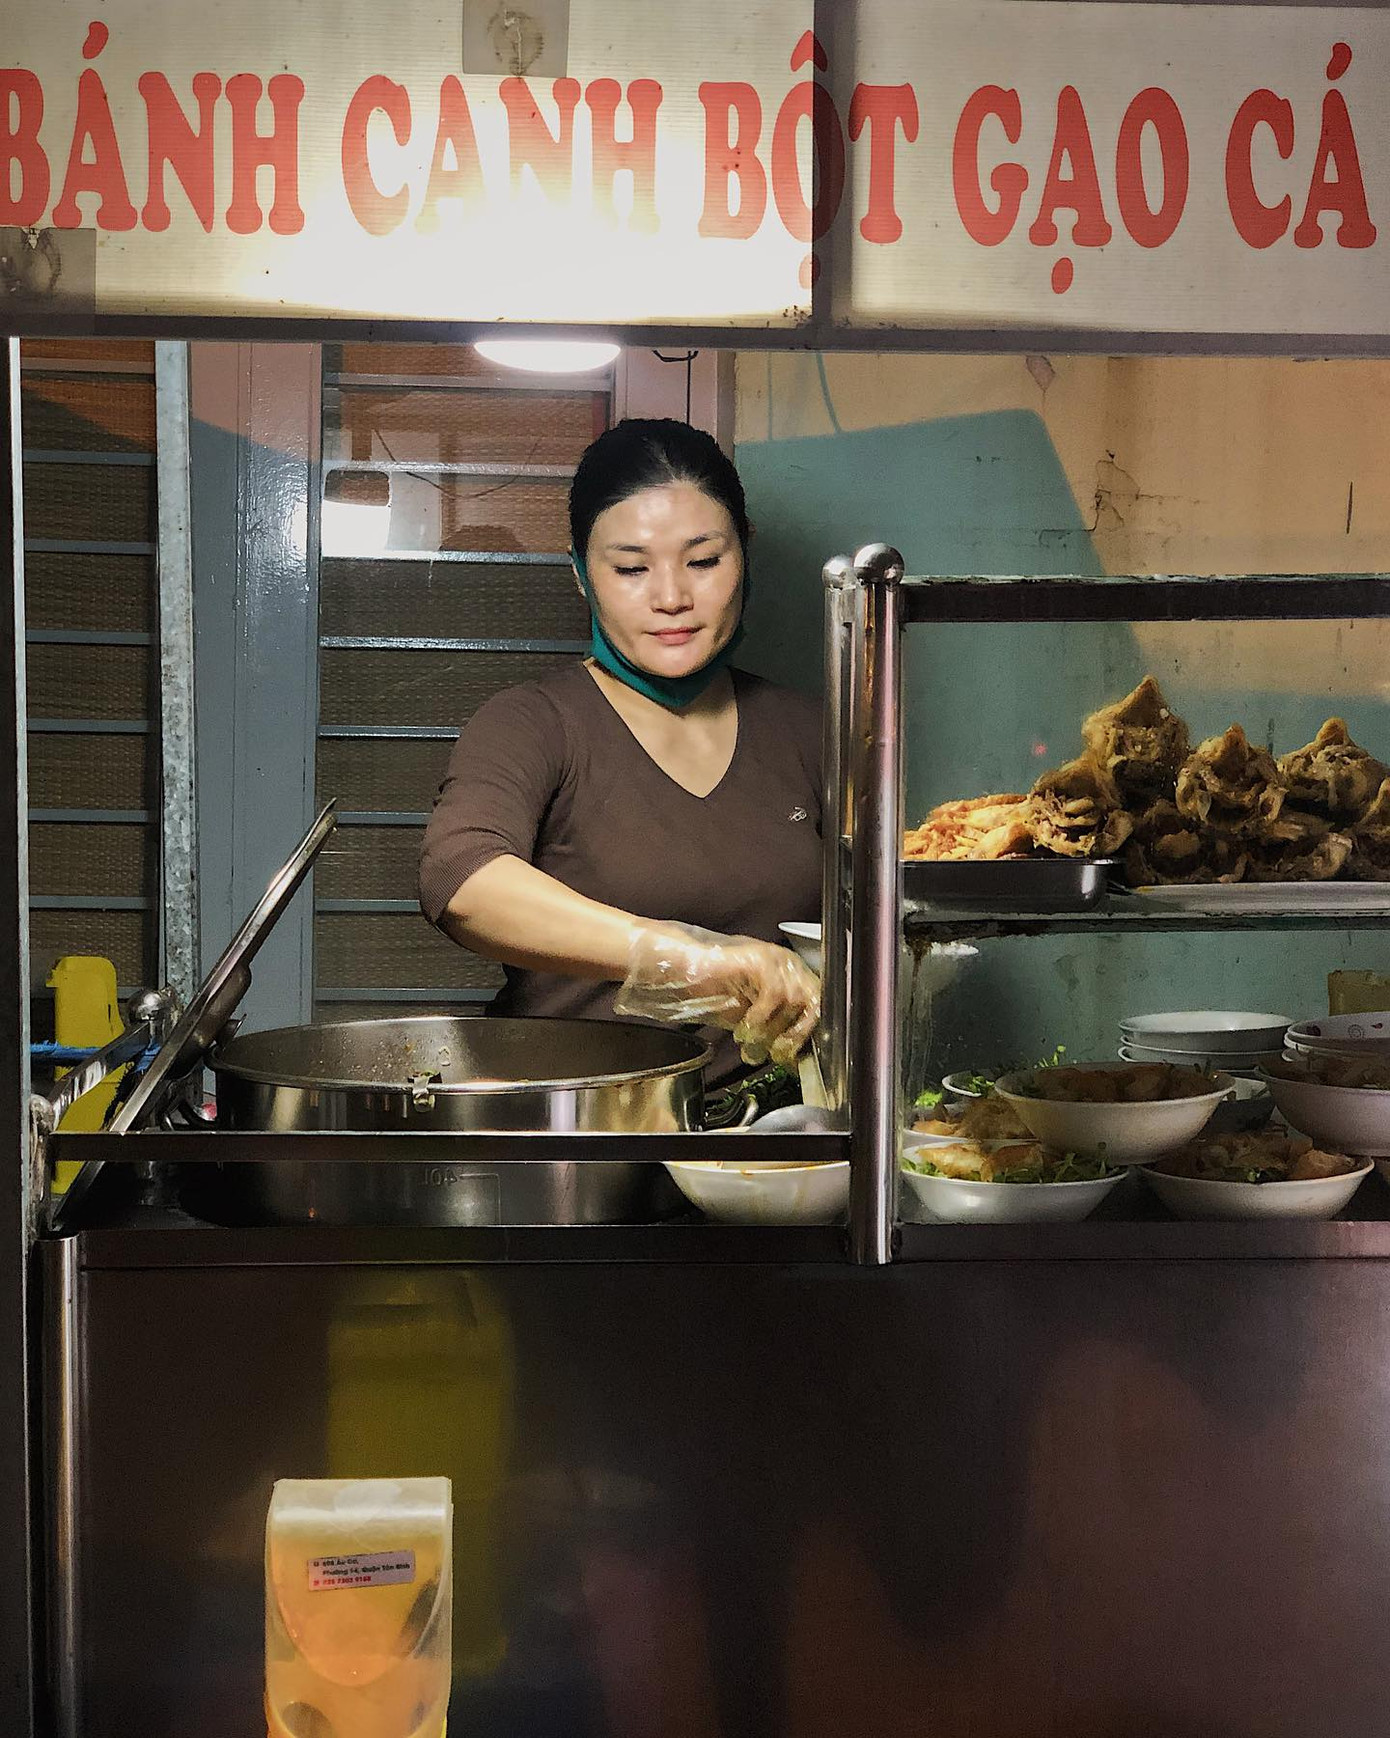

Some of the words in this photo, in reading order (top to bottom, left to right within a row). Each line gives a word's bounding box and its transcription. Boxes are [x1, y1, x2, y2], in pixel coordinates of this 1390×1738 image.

[0, 21, 304, 235] BÁNH
[341, 74, 663, 236] CANH
[698, 30, 919, 290] BỘT
[952, 85, 1189, 294] GẠO
[1225, 42, 1377, 249] CÁ
